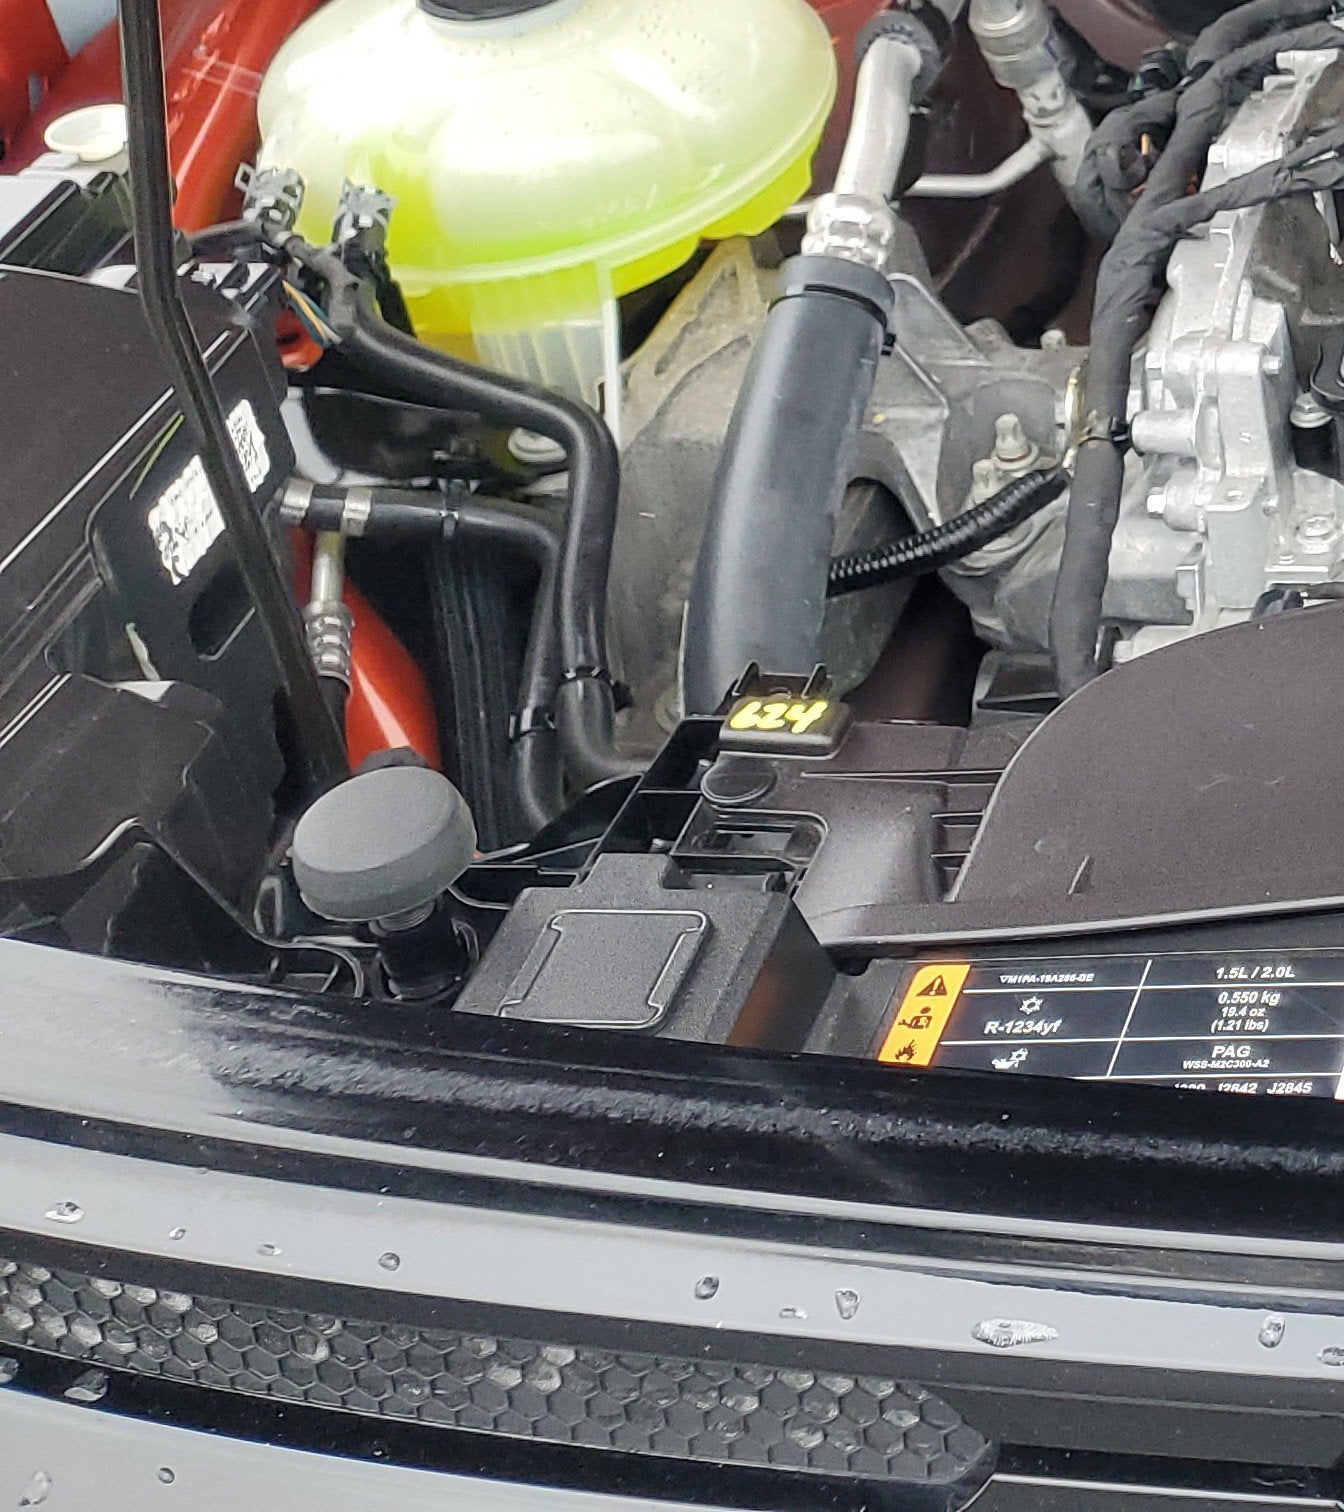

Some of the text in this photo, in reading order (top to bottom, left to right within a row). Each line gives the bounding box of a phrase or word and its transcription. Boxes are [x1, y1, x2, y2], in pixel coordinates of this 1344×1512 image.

[730, 701, 828, 733] 624
[1216, 967, 1248, 979] 1.5L
[1260, 965, 1295, 978] 2.0L
[1218, 991, 1281, 1006] 0.550 kg
[1222, 1006, 1266, 1017] 19.4 oz
[984, 1019, 1063, 1035] R-1234yf
[1211, 1019, 1270, 1033] (1.21 lbs)
[1212, 1045, 1251, 1058] PAG
[1267, 1082, 1313, 1094] J2845
